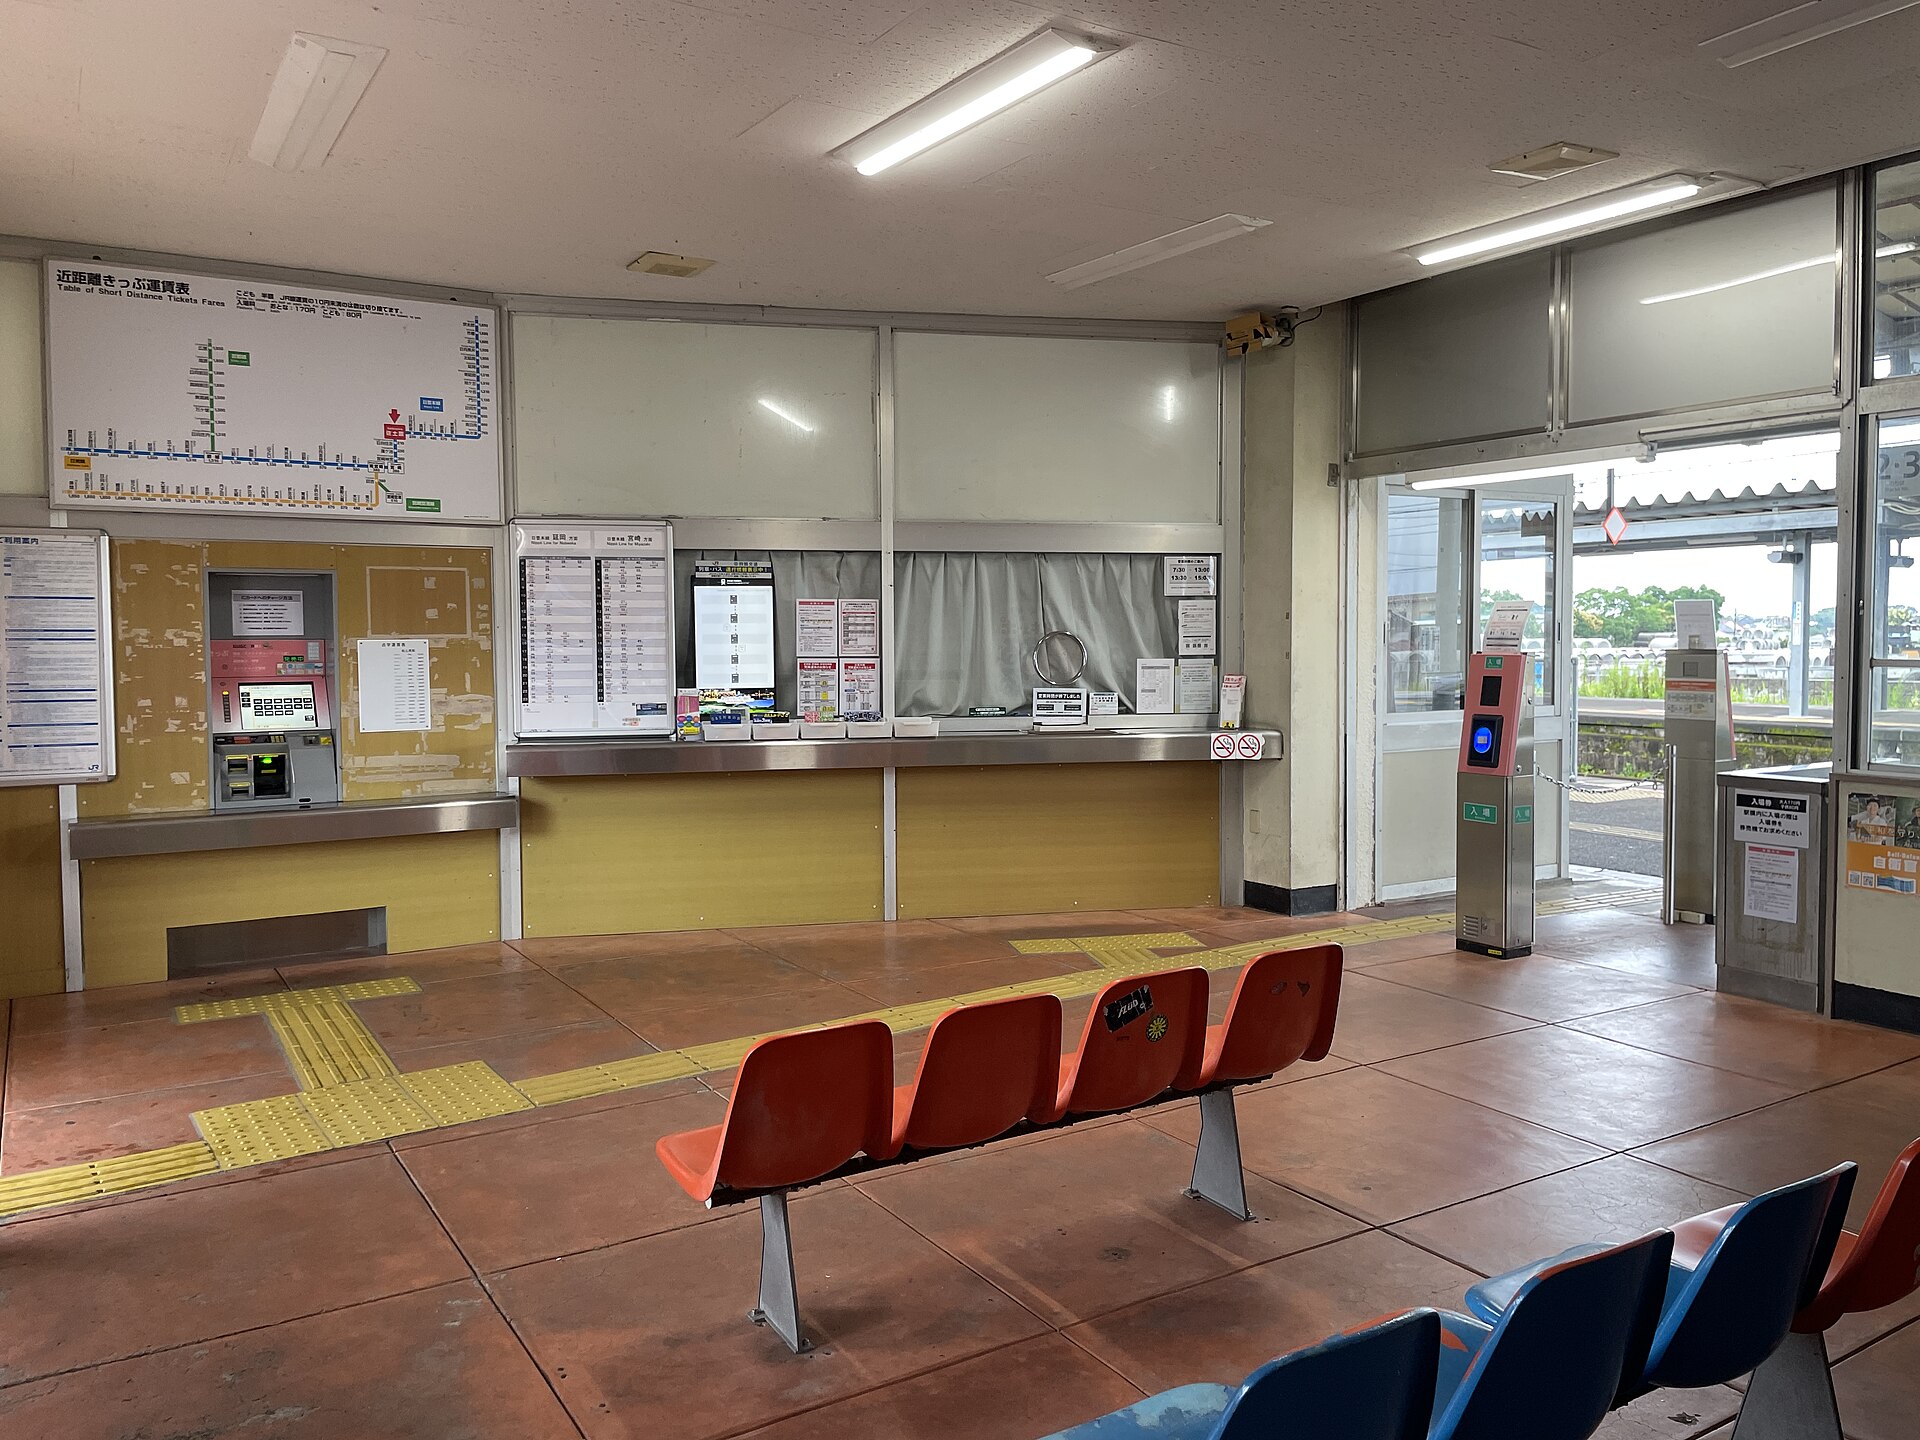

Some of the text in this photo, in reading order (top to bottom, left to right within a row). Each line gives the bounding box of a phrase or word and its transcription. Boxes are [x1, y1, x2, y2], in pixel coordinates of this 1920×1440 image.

[57, 269, 190, 295] 近距離きっぷ運賃表
[57, 284, 81, 293] Table
[98, 288, 122, 297] Short
[126, 290, 163, 301] Distance
[167, 294, 198, 304] Tickets
[201, 298, 226, 307] Fares
[1751, 797, 1772, 807] 入場券
[1470, 806, 1490, 817] 入場
[1758, 818, 1782, 827] 入場券を
[1740, 825, 1803, 837] 券売機でお求めください
